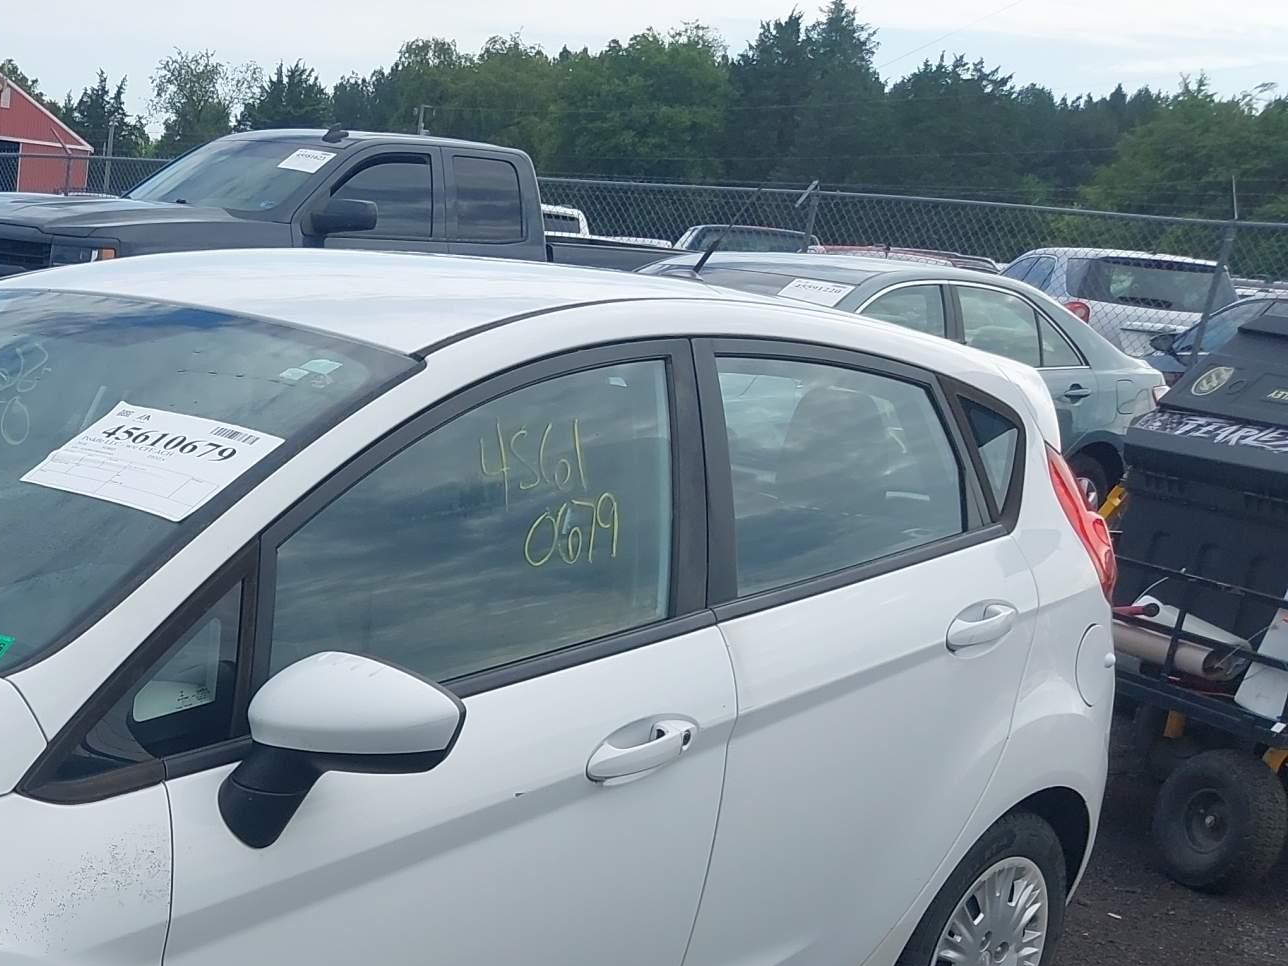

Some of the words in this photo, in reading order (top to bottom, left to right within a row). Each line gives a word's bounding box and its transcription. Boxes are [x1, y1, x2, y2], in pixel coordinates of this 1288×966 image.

[101, 424, 237, 463] 45610679
[479, 417, 588, 512] 4561
[524, 491, 620, 567] 0679
